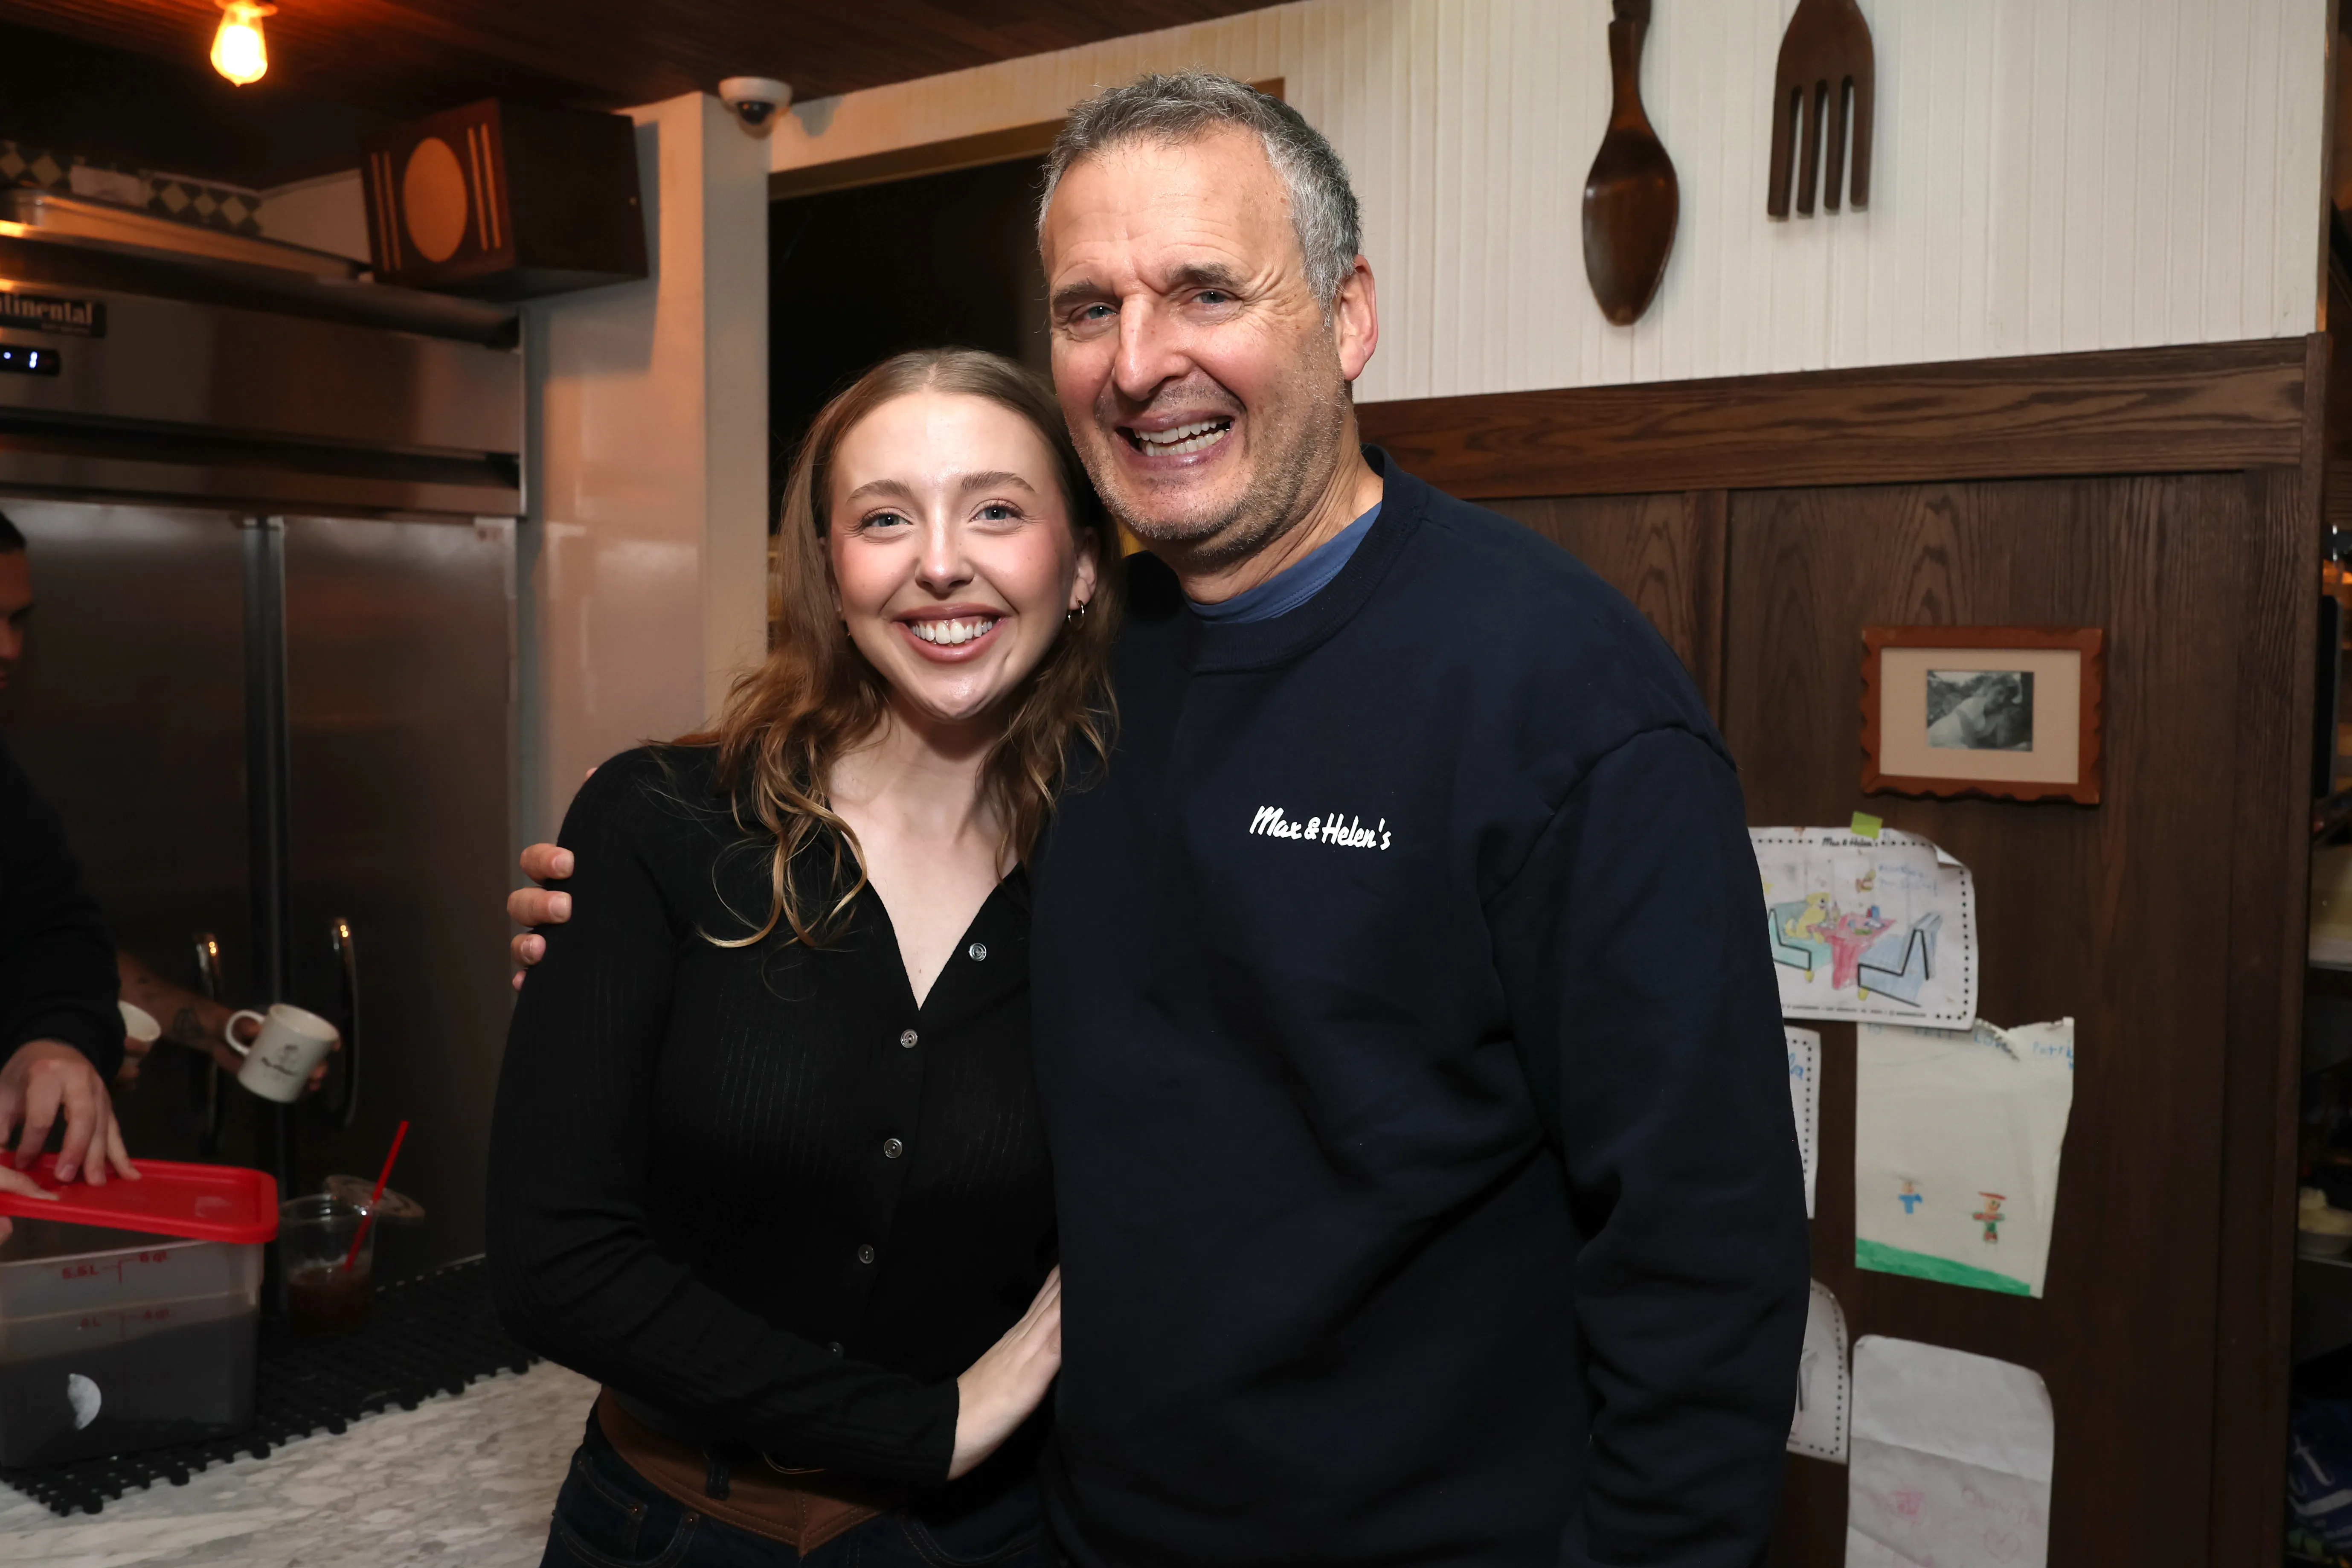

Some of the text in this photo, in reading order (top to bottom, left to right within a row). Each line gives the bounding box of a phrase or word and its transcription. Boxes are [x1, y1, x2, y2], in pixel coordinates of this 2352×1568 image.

[0, 294, 92, 324] tinental
[1249, 805, 1391, 850] Max & Helen's
